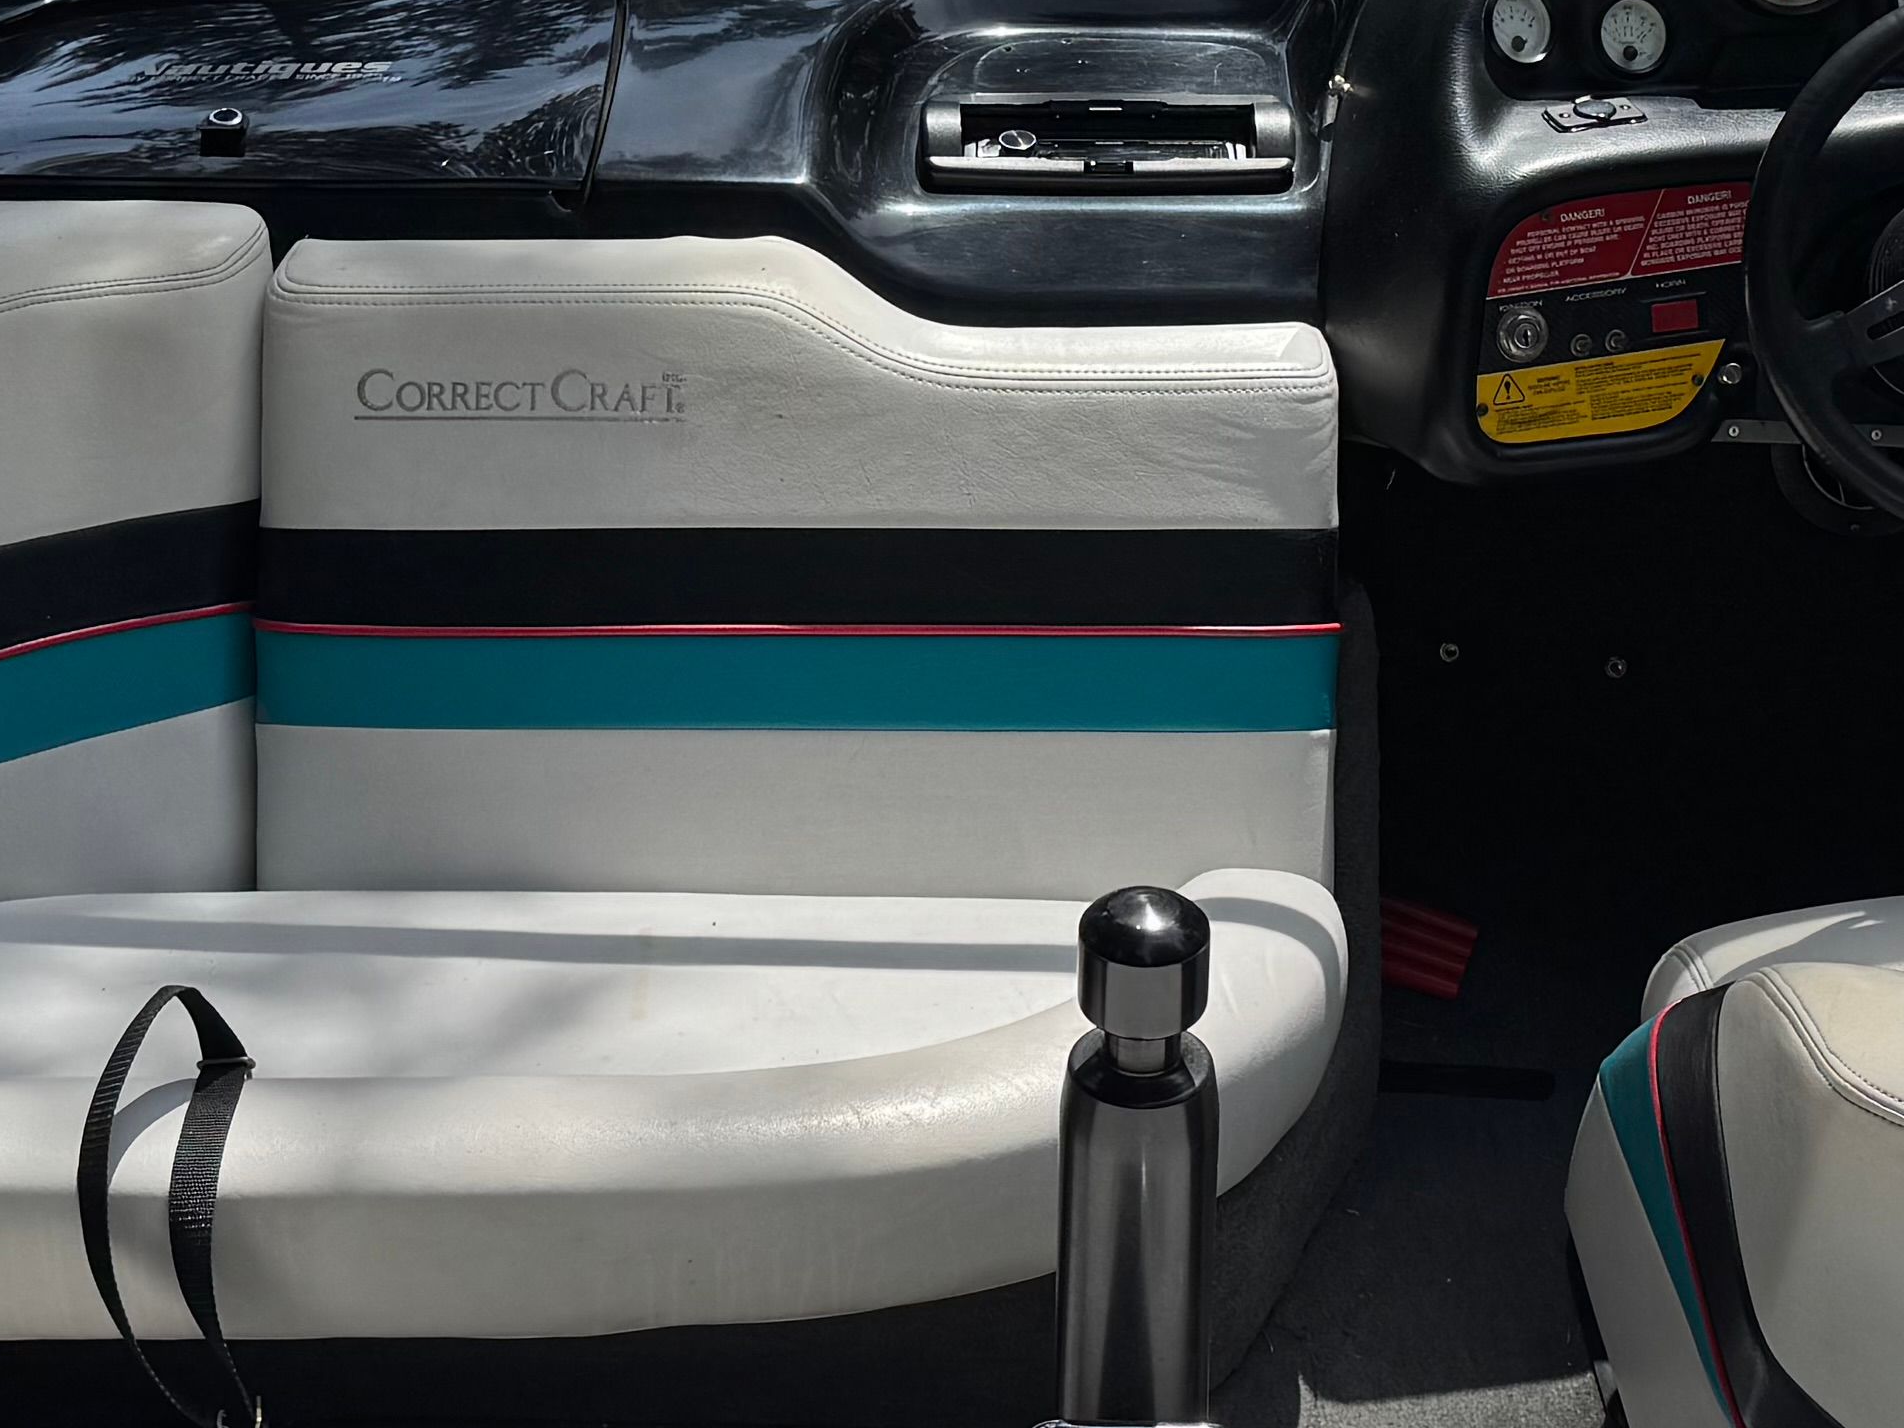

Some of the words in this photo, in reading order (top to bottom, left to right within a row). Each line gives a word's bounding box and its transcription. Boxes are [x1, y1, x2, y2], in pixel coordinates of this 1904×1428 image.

[146, 60, 393, 80] Nautiques
[1687, 190, 1732, 205] DANGER!
[1560, 208, 1606, 222] DANGER!
[357, 369, 546, 412] CORRECT
